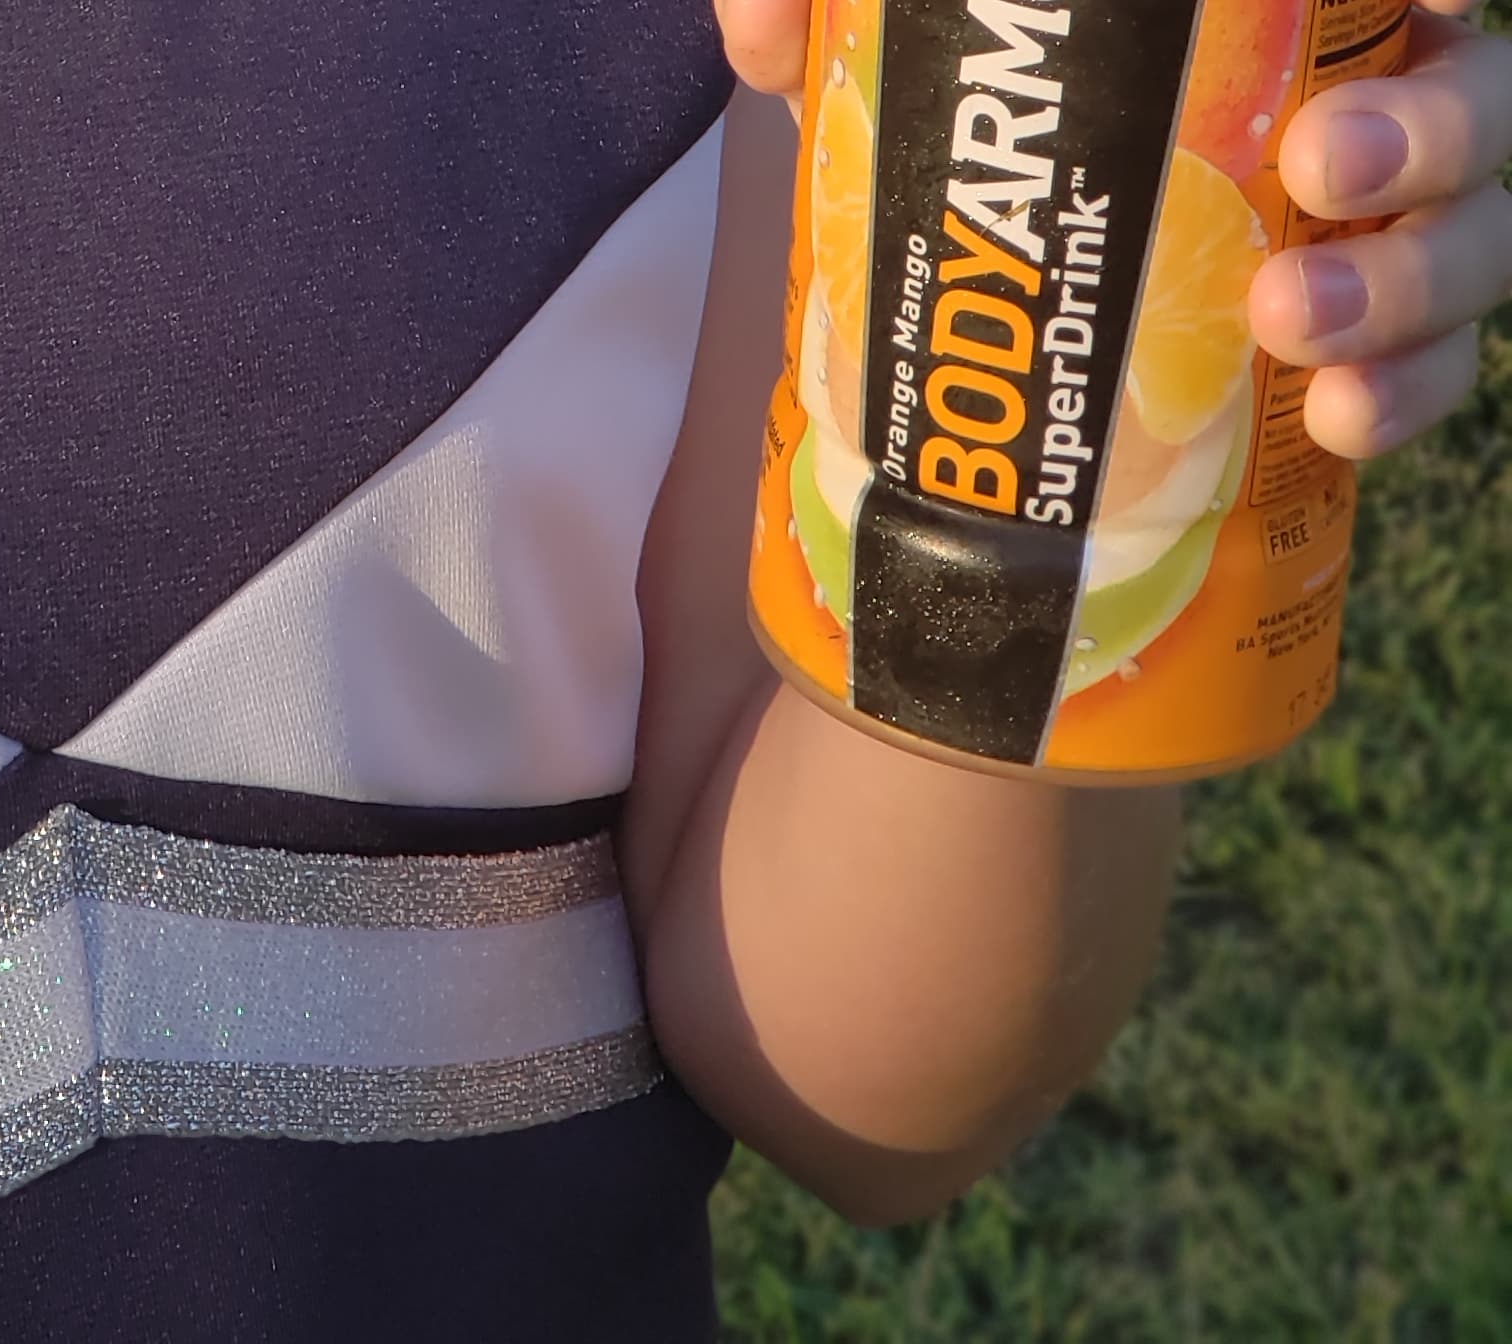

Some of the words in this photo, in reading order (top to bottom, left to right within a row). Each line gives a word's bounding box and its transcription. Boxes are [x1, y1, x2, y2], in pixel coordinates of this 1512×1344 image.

[892, 234, 931, 353] Mango
[882, 360, 918, 483] Orange
[1270, 522, 1311, 557] FREE
